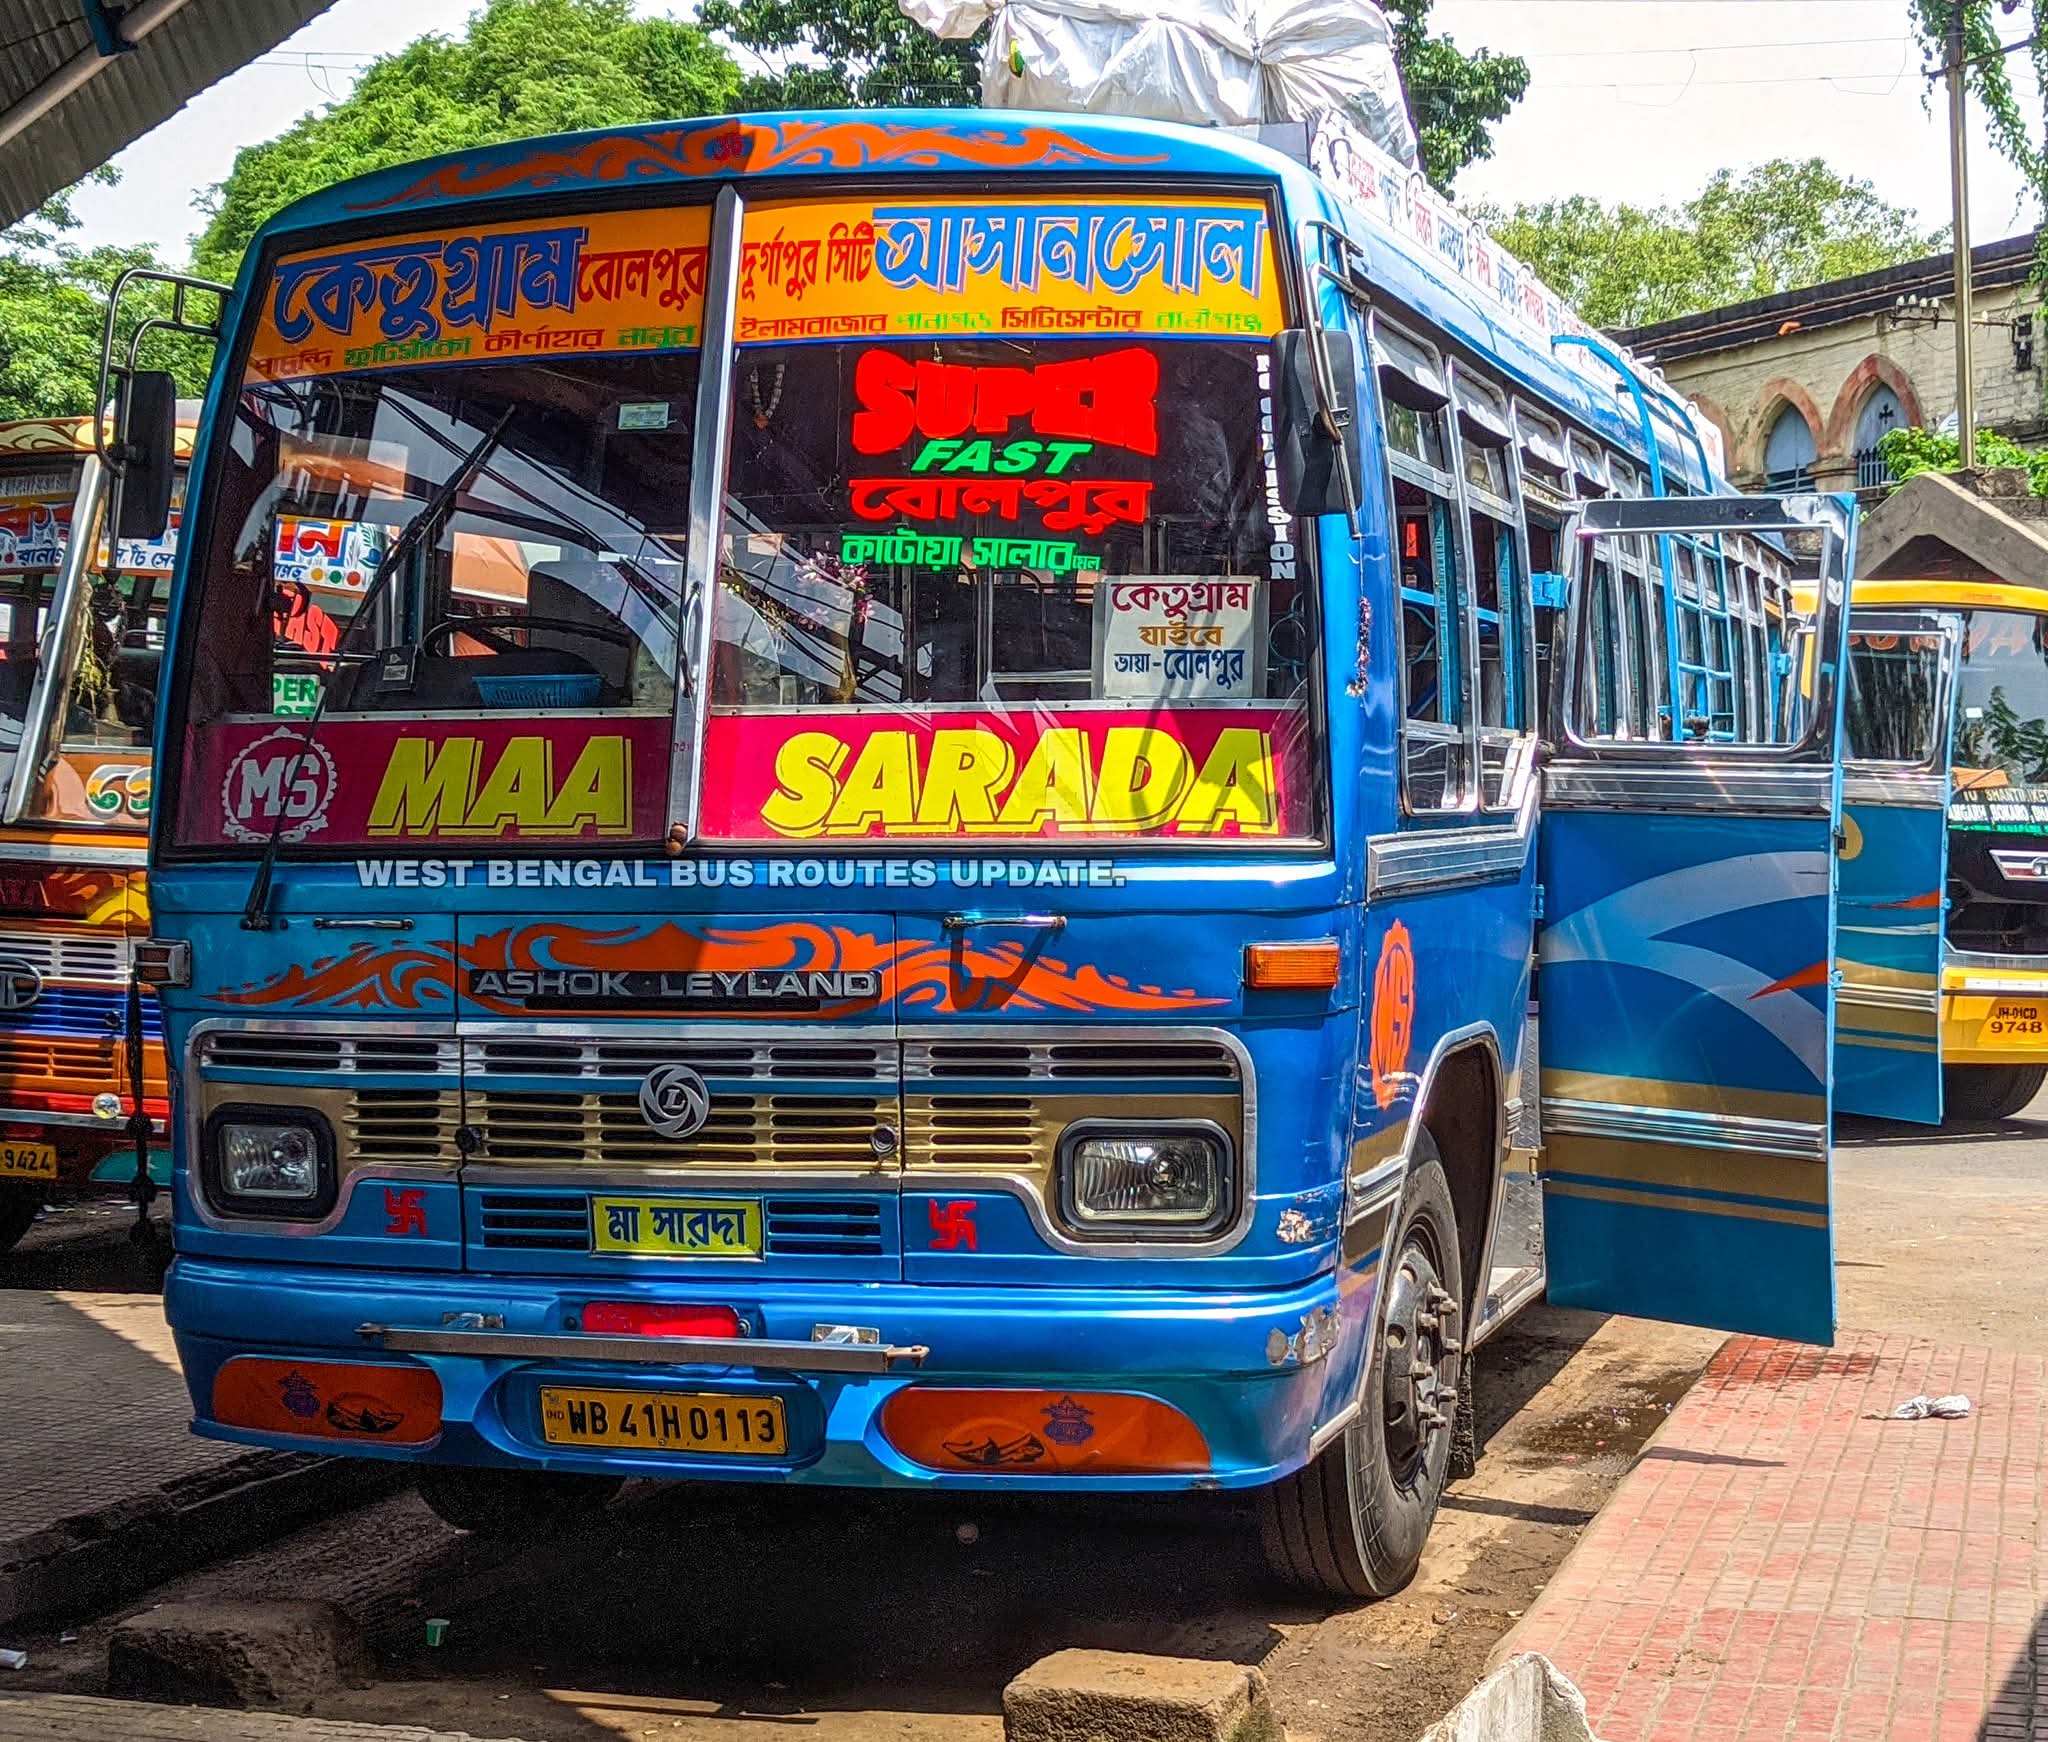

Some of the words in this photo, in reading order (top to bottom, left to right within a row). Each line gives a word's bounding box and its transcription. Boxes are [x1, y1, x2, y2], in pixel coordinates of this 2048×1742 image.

[826, 221, 876, 283] সিটি
[872, 206, 1264, 300] আসানসোল
[273, 227, 588, 343] কেতুগ্রাম
[577, 246, 708, 311] বোলপুর
[484, 325, 606, 352] কীর্ণাহার
[740, 314, 889, 339] ইলামবাজার
[852, 347, 1159, 456] SUPER
[911, 439, 1093, 474] FAST
[849, 478, 1154, 535] বোলপুর
[842, 527, 963, 572] কাটোয়া
[972, 536, 1077, 576] সালার
[1111, 582, 1252, 621] কেতুগ্রাম
[1138, 621, 1224, 647] যাইবে
[237, 754, 325, 821] MS
[367, 735, 633, 836] MAA
[760, 726, 1279, 838] SARADA
[473, 971, 633, 996] ASHOK
[660, 970, 877, 998] LEYLAND
[1990, 1021, 2042, 1034] 9748
[605, 1205, 640, 1243] মা
[650, 1207, 747, 1248] সারদা
[567, 1400, 609, 1435] WB
